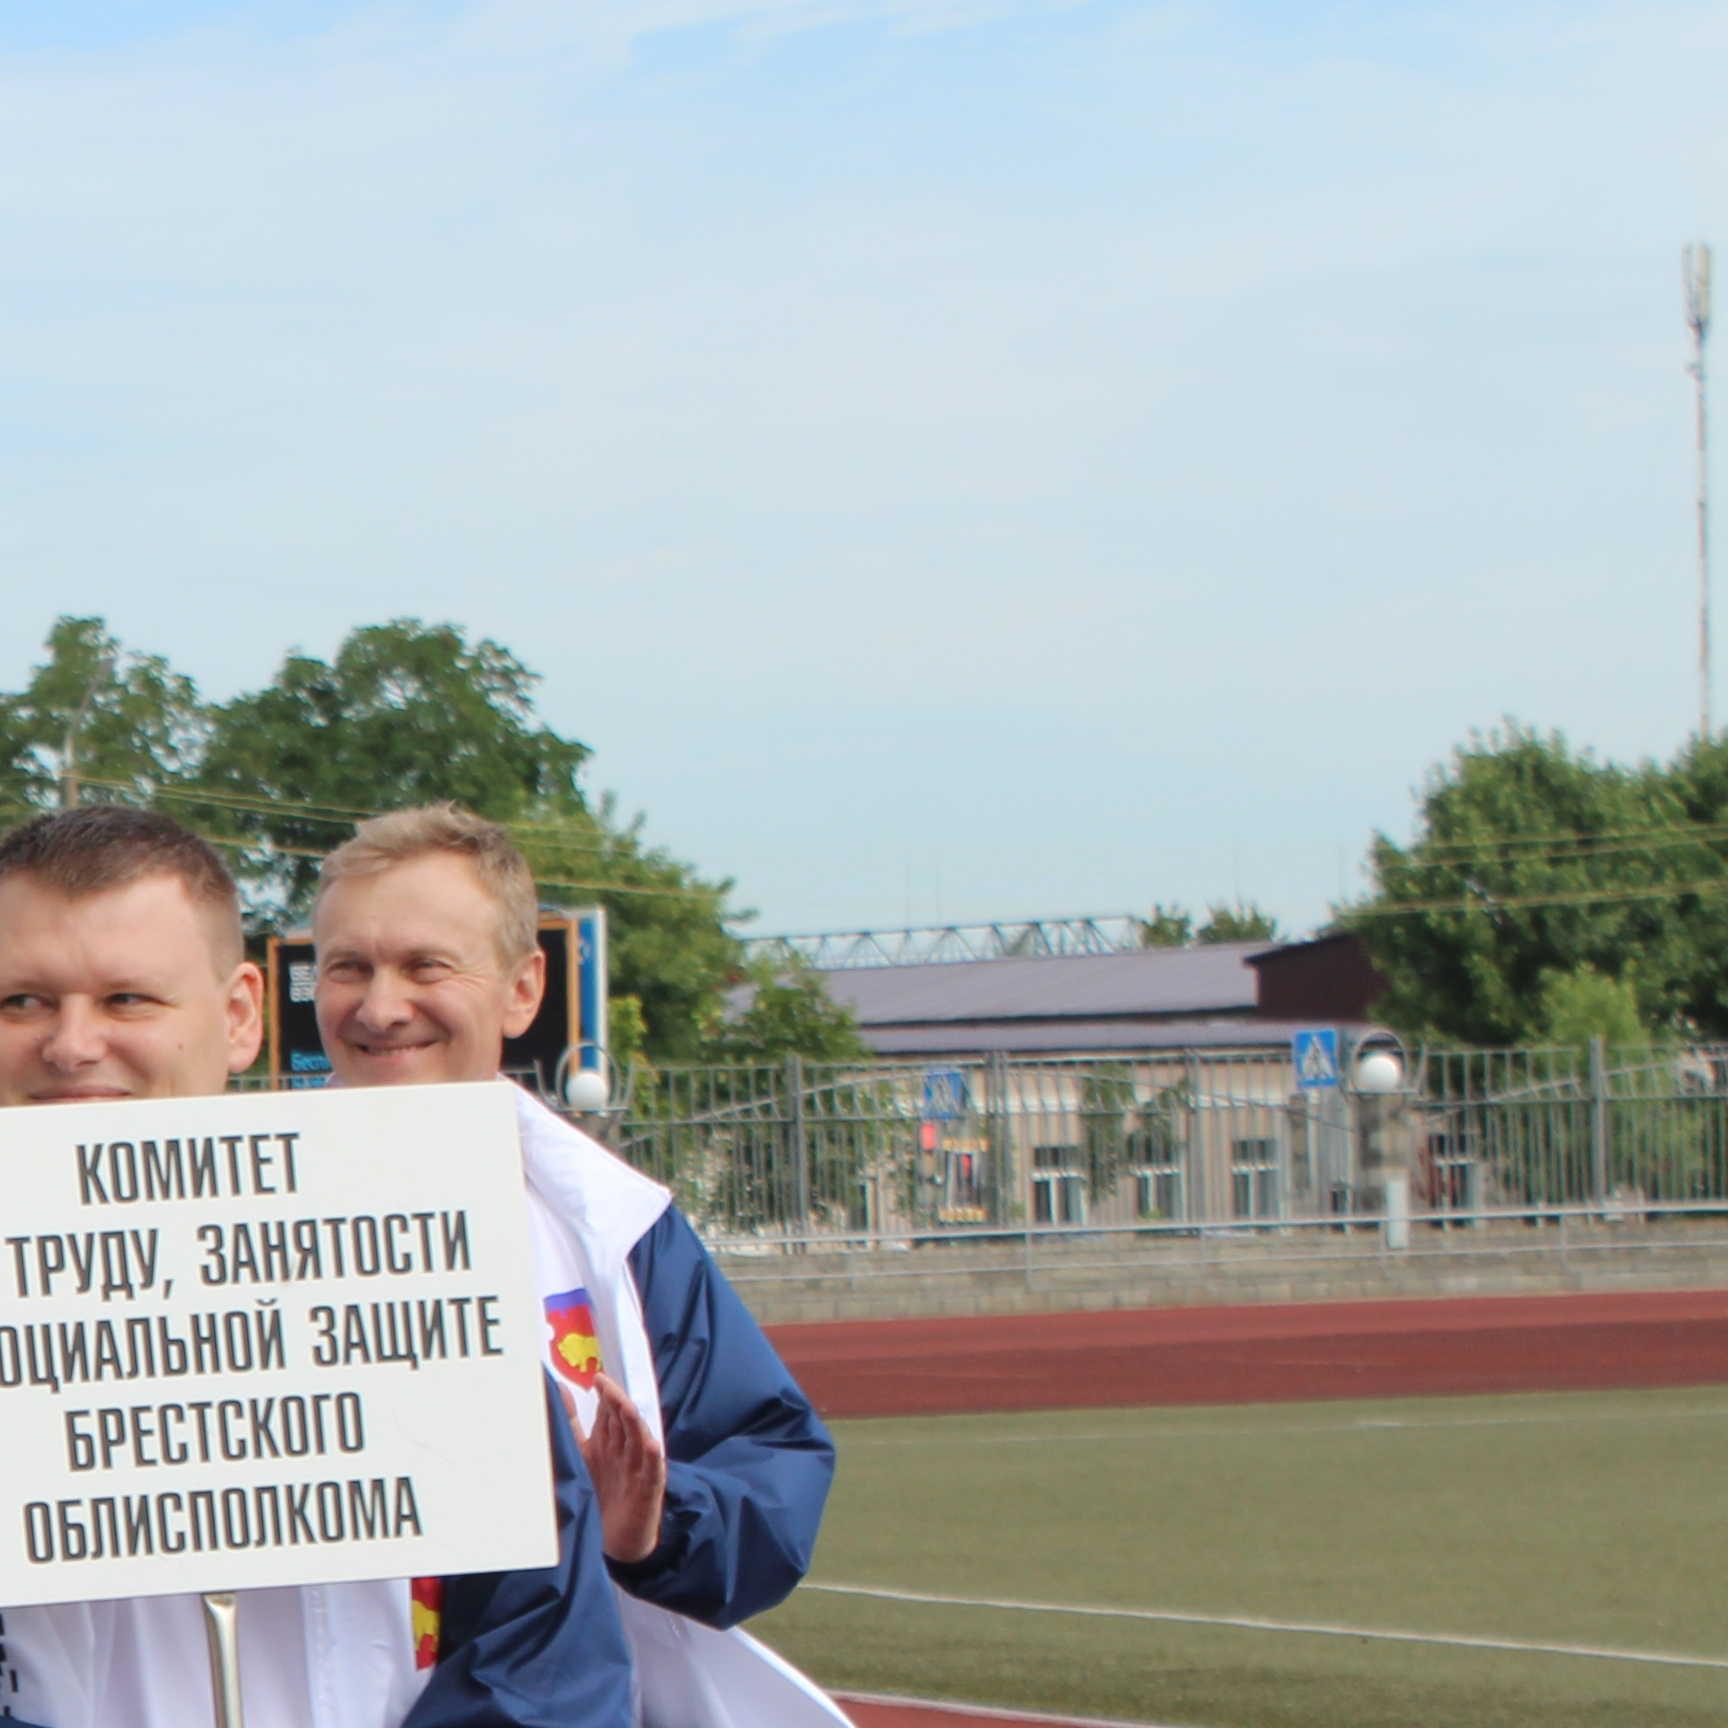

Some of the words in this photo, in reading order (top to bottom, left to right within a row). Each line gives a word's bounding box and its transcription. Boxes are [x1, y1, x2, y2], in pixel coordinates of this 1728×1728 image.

[76, 1132, 301, 1205] КОМИТЕТ
[5, 1228, 174, 1302] ТРУДУ,
[197, 1210, 472, 1286] ЗАНЯТОСТИ
[309, 1295, 504, 1370] ЗАЩИТЕ
[65, 1391, 365, 1472] БРЕСТСКОГО
[24, 1476, 422, 1564] ОБЛИСПОЛКОМА
